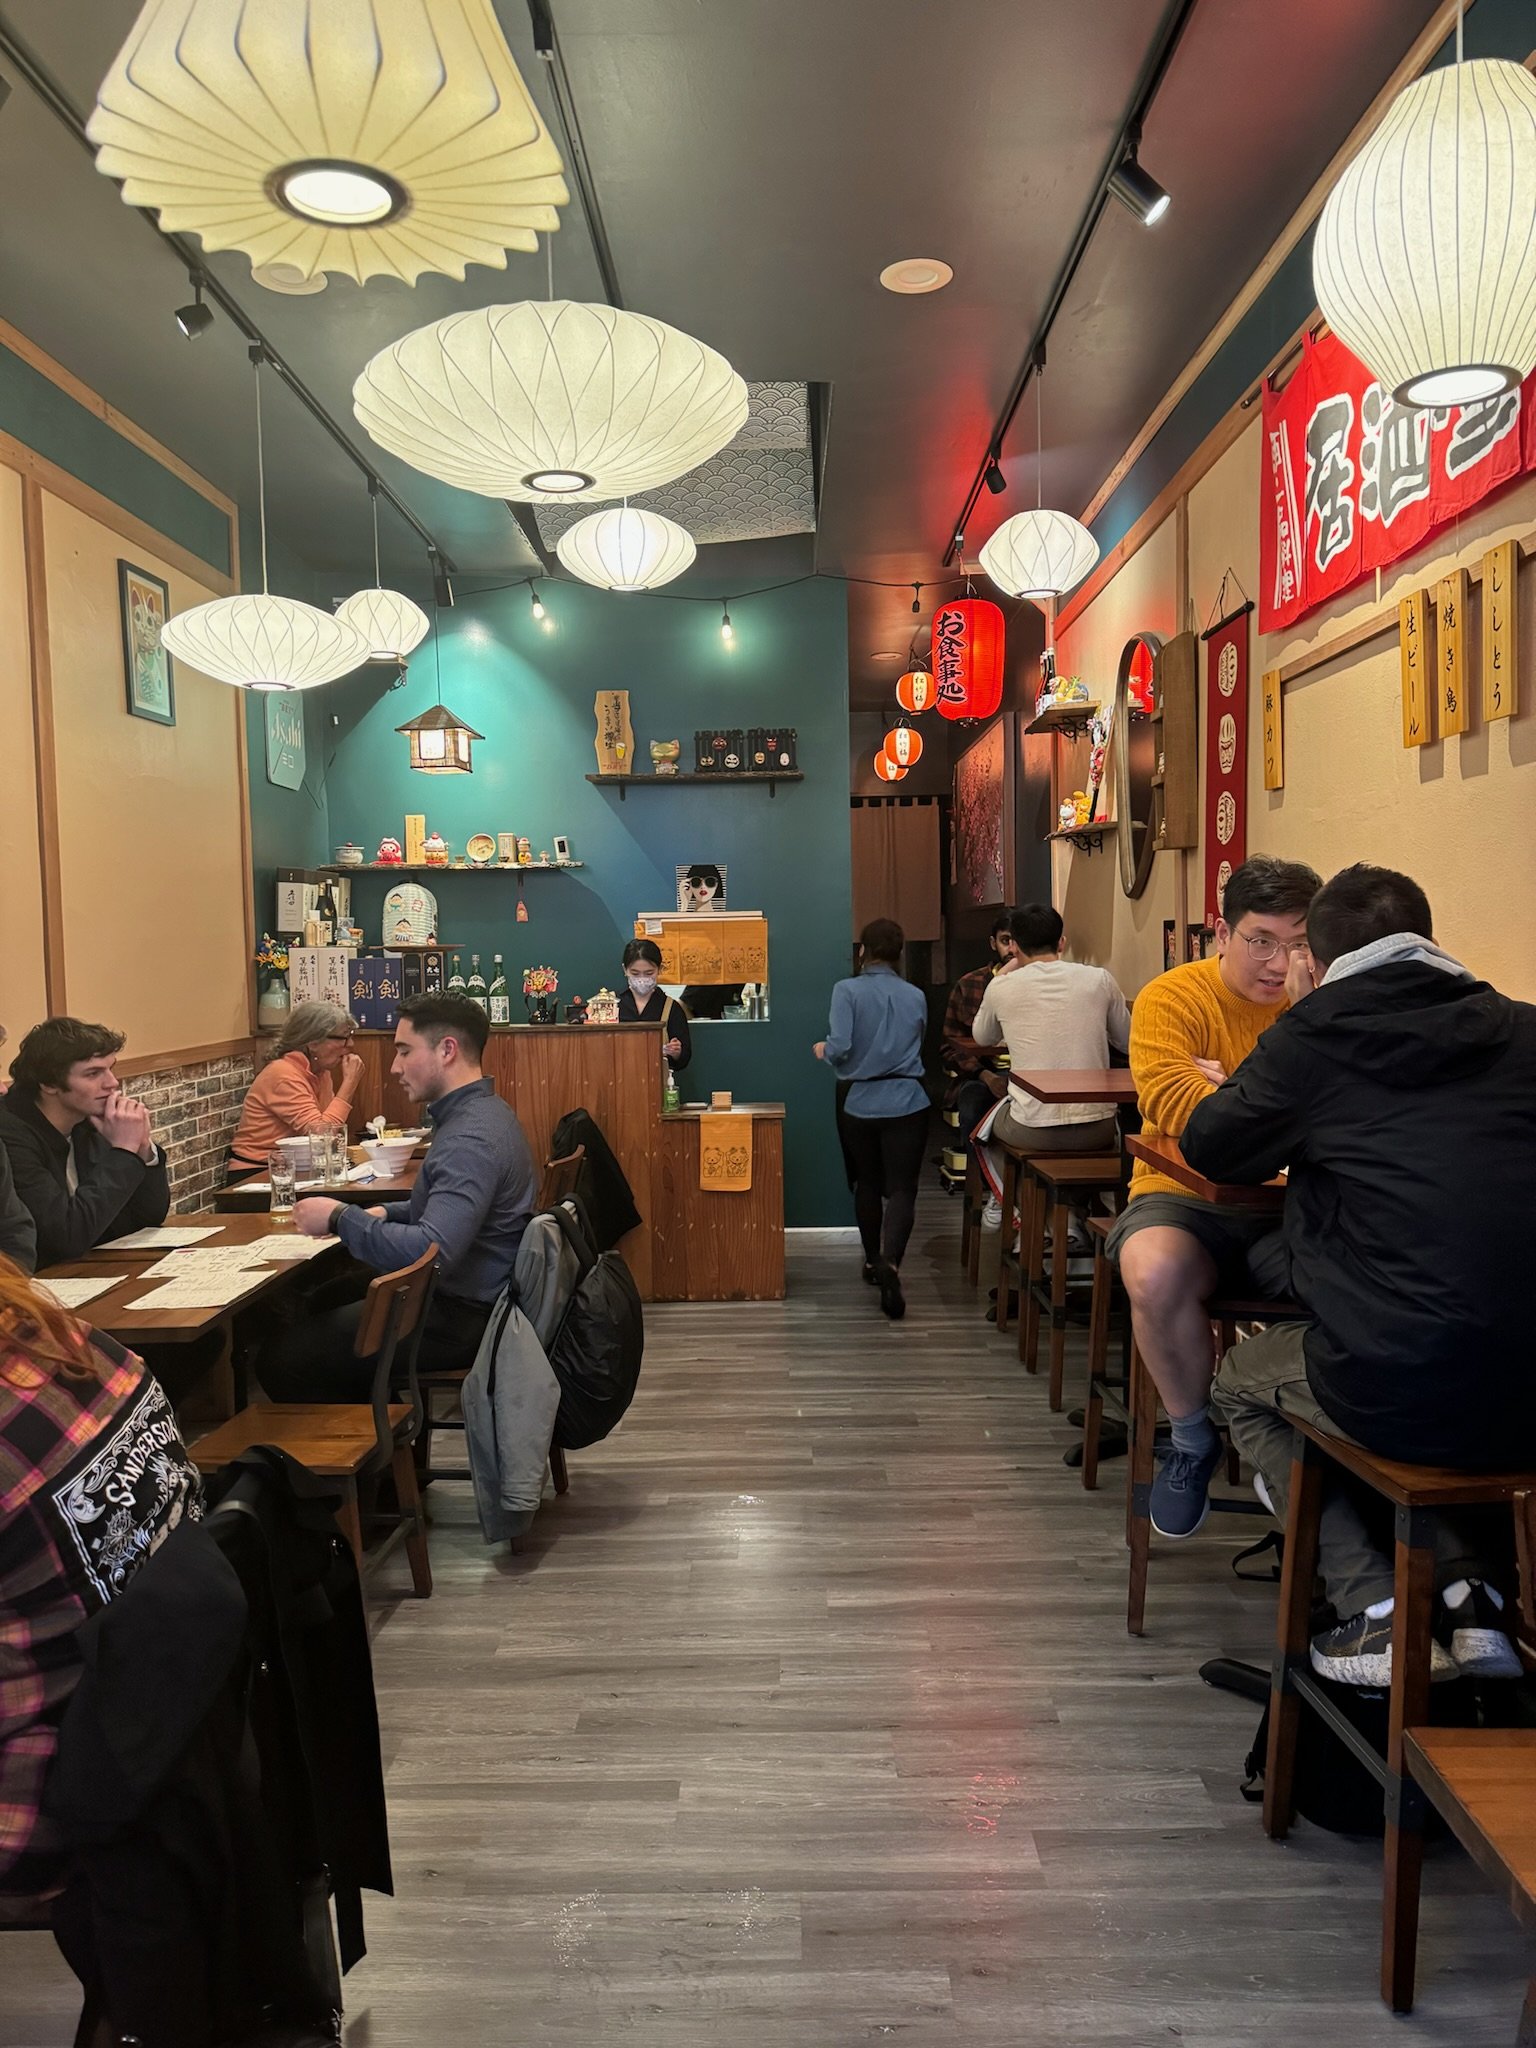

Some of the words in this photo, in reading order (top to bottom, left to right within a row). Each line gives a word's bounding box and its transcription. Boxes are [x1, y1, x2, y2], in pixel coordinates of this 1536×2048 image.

[936, 610, 968, 705] お食事処
[1405, 611, 1421, 737] 生ビール
[1443, 602, 1458, 714] 焼き鳥
[1492, 567, 1504, 712] ししとう
[271, 711, 302, 751] Asahi
[351, 979, 374, 1000] 剣
[377, 978, 400, 1000] 剣
